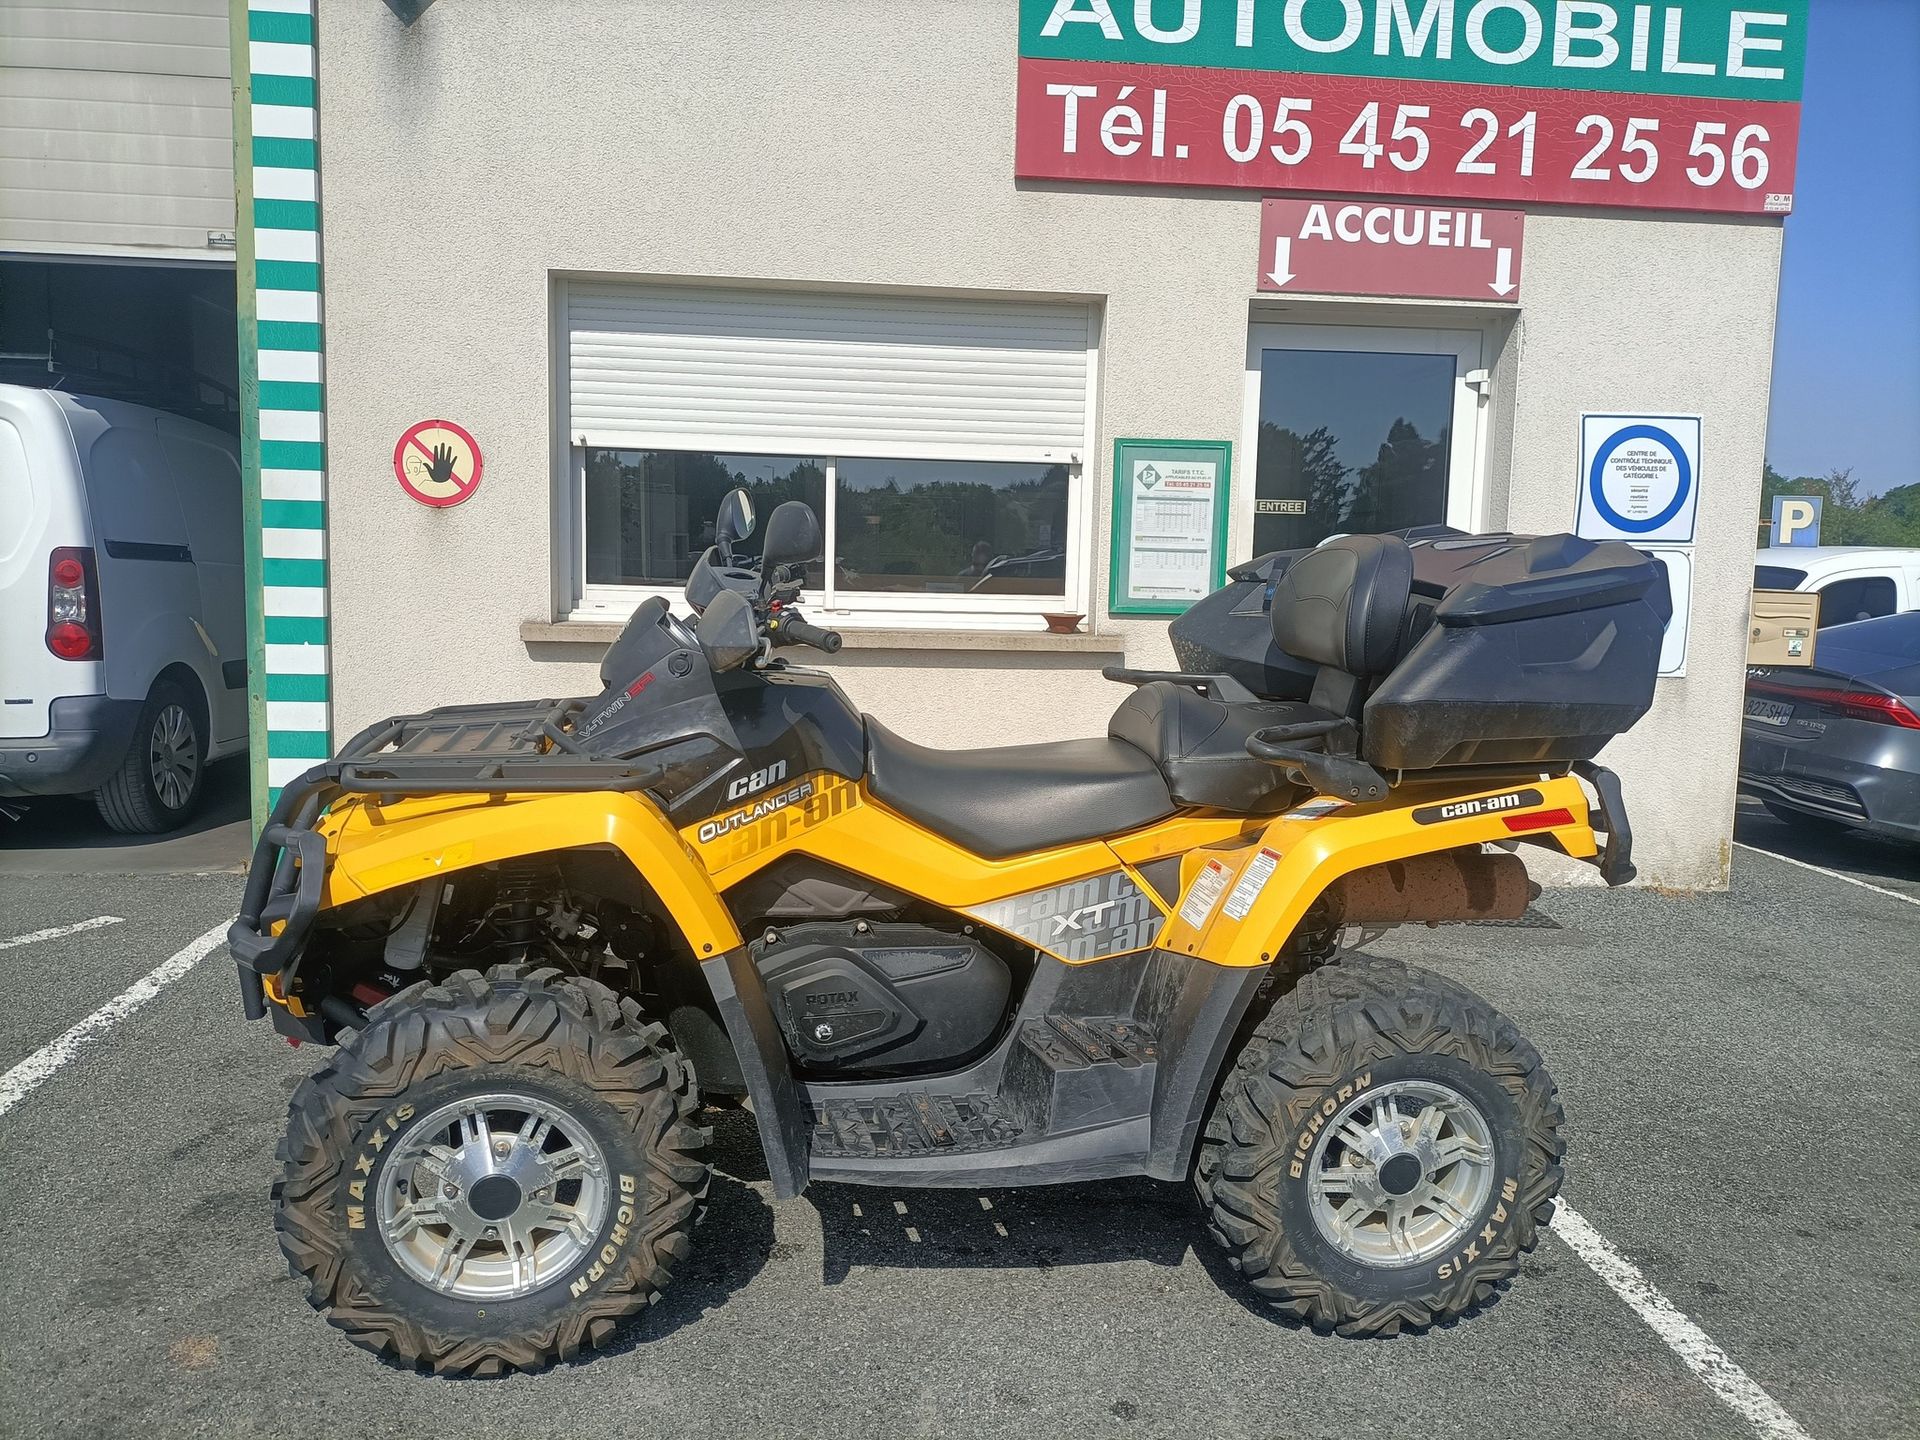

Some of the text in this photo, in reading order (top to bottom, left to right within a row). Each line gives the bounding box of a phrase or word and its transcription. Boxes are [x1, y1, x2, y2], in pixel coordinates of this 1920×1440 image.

[1040, 0, 1789, 80] AUTOMOBILE
[1046, 84, 1771, 190] Tél. 05 45 21 25 56
[1298, 203, 1492, 249] ACCUEIL
[1259, 502, 1302, 512] ENTREE
[1779, 500, 1815, 544] P
[699, 782, 814, 843] OUTLANDER
[1441, 793, 1520, 819] can-am
[1051, 900, 1116, 937] XT
[1289, 1071, 1373, 1180] BIGHORN
[348, 1102, 416, 1230] MAXXIS
[567, 1173, 637, 1300] BIGHORN
[1437, 1176, 1519, 1282] MAXXIS
